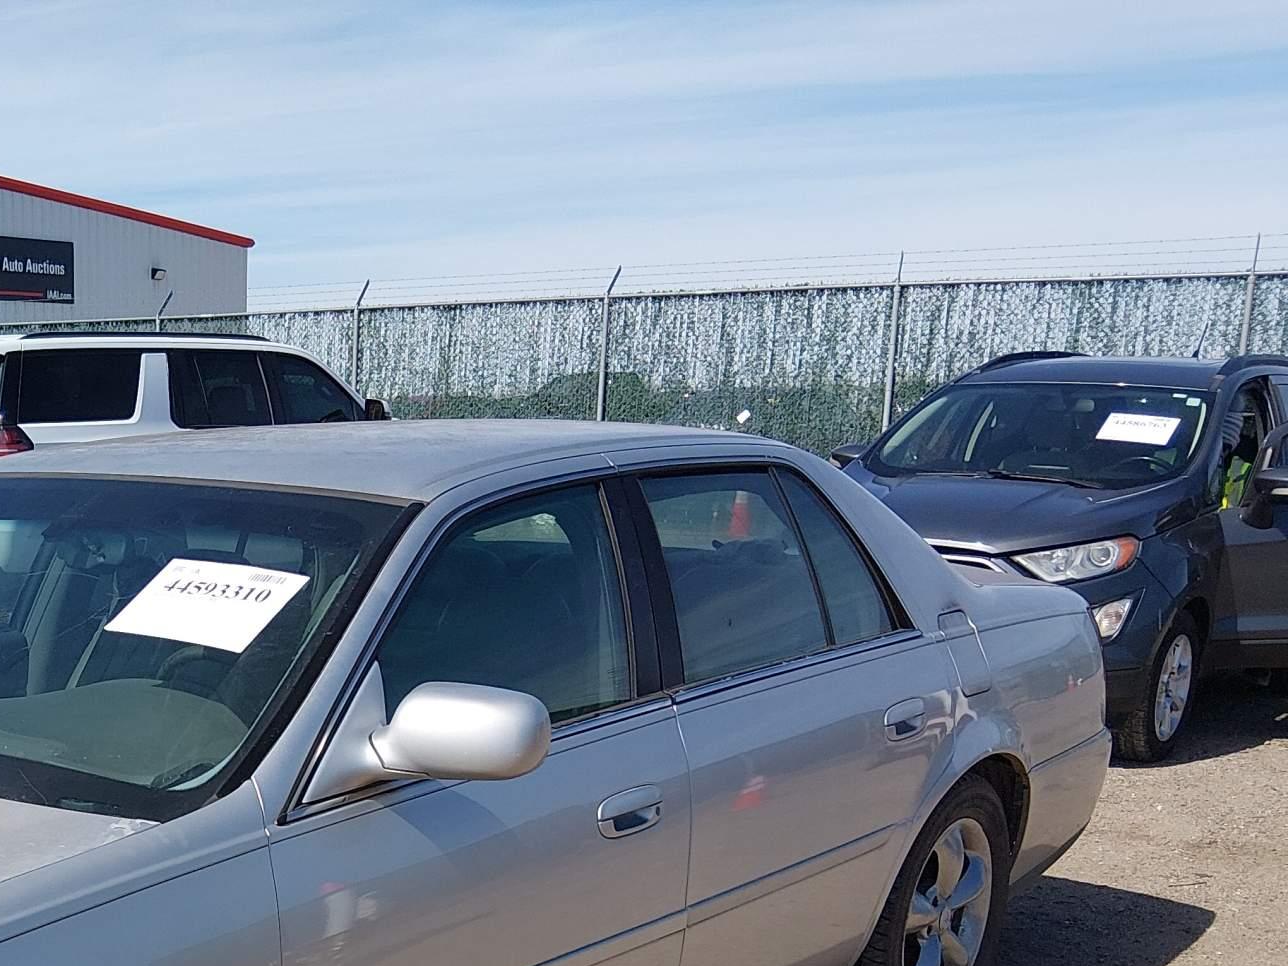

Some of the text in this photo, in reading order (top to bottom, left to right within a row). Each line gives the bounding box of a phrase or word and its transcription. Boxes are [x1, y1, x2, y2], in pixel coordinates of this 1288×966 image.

[2, 257, 23, 273] Auto
[25, 259, 65, 275] Auctions
[163, 578, 272, 603] 44593310
